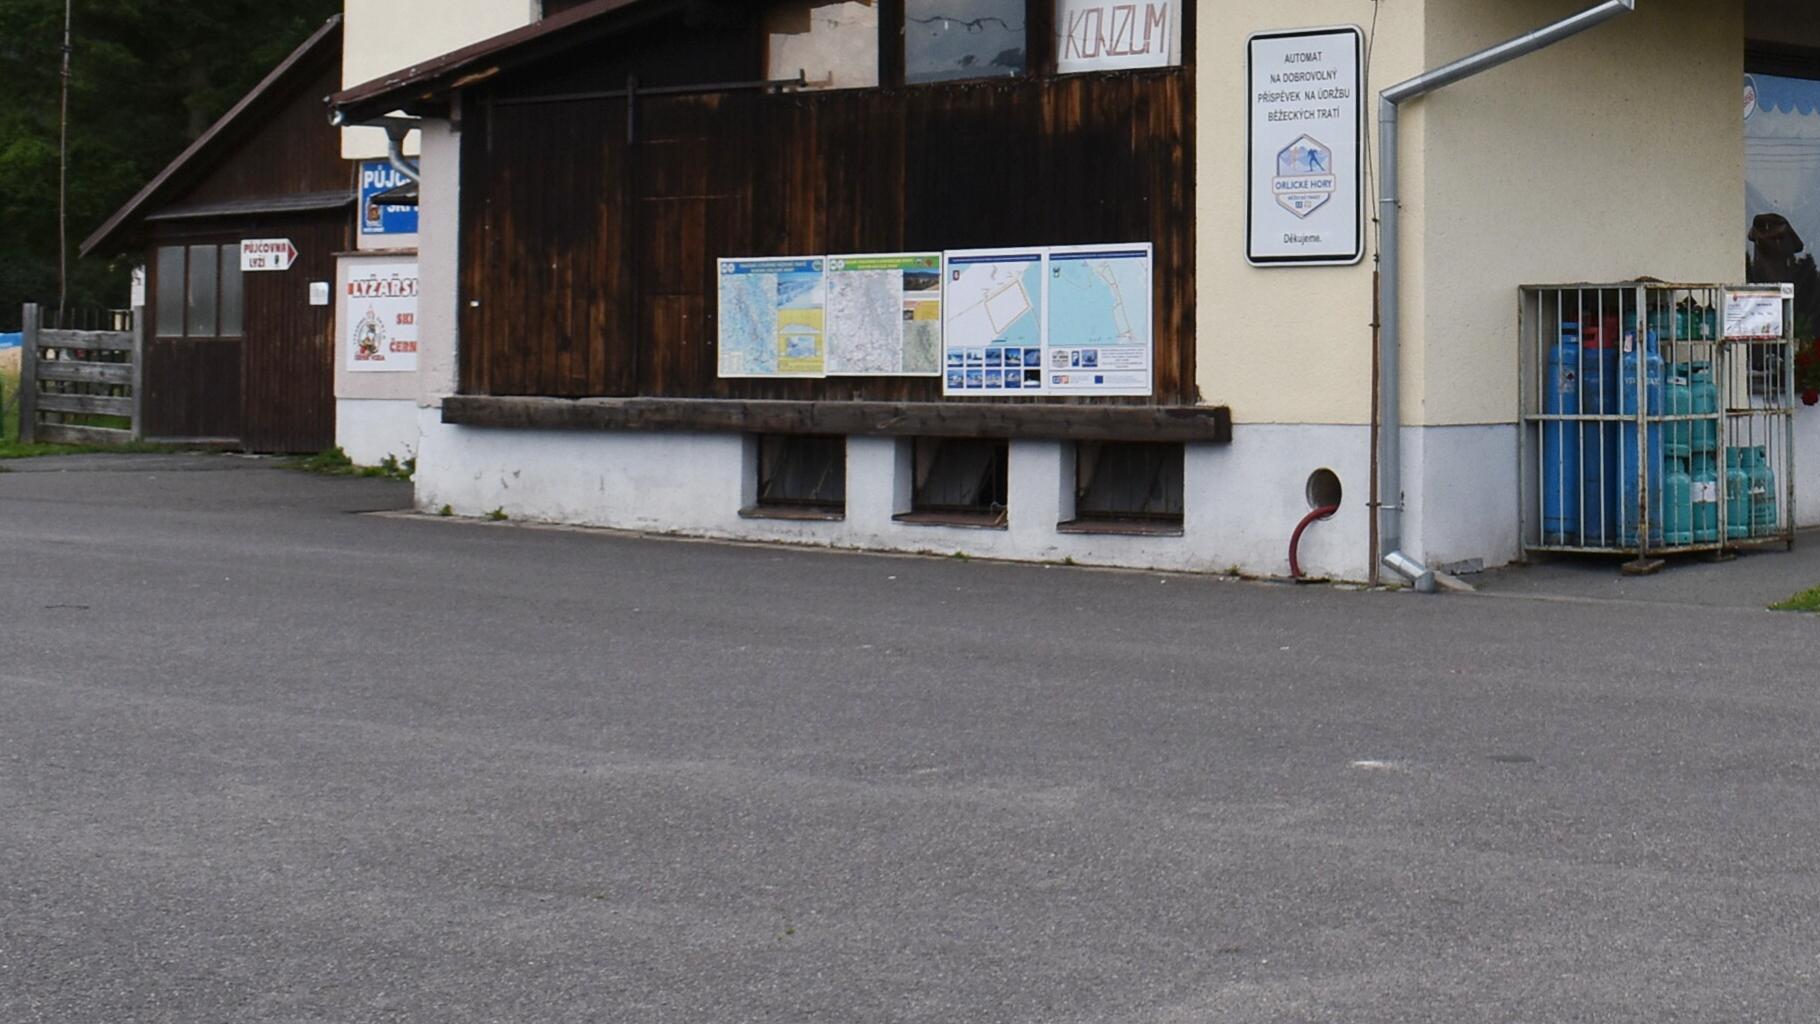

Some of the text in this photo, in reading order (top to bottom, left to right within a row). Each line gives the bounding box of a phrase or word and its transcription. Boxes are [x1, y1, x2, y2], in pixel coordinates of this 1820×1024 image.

[1065, 2, 1168, 60] KONZUM
[1284, 51, 1322, 64] AUTOMAT
[1270, 68, 1338, 84] NA DOBROVOLNÝ
[1305, 90, 1316, 100] NA
[1318, 86, 1350, 100] ÚDRŽBU
[1317, 105, 1340, 119] TRATÍ
[1311, 179, 1333, 188] HORY
[396, 313, 414, 325] SKI
